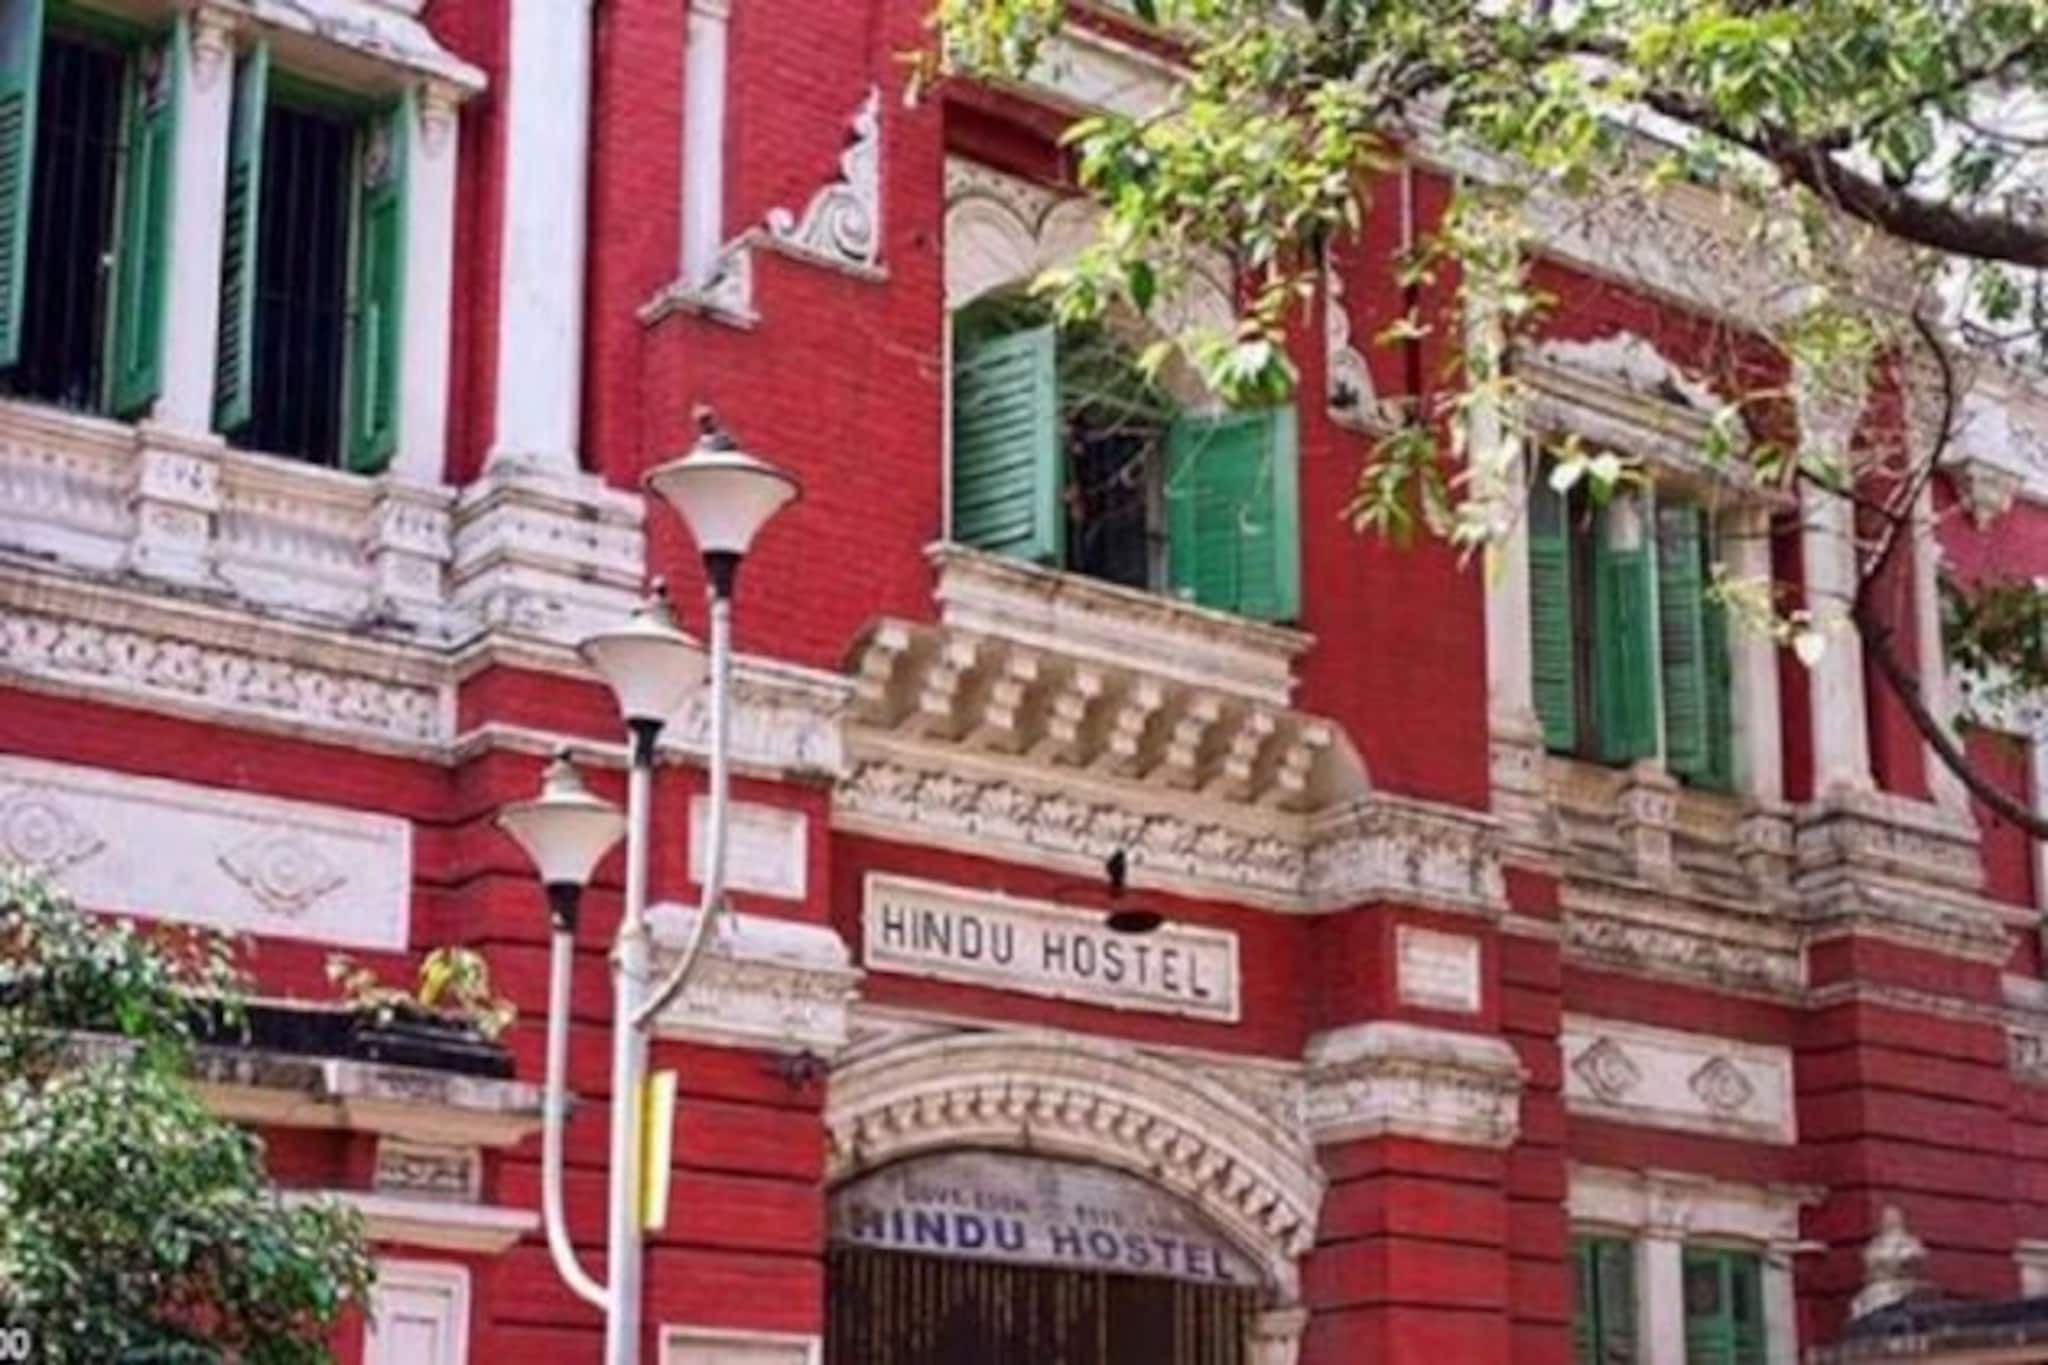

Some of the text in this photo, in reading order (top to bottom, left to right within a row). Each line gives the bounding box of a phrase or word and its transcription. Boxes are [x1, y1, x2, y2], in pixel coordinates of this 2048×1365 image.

[881, 902, 1211, 998] HINDU HOSTEL
[850, 1204, 1025, 1251] HINDU
[1048, 1225, 1233, 1280] HOSTEL
